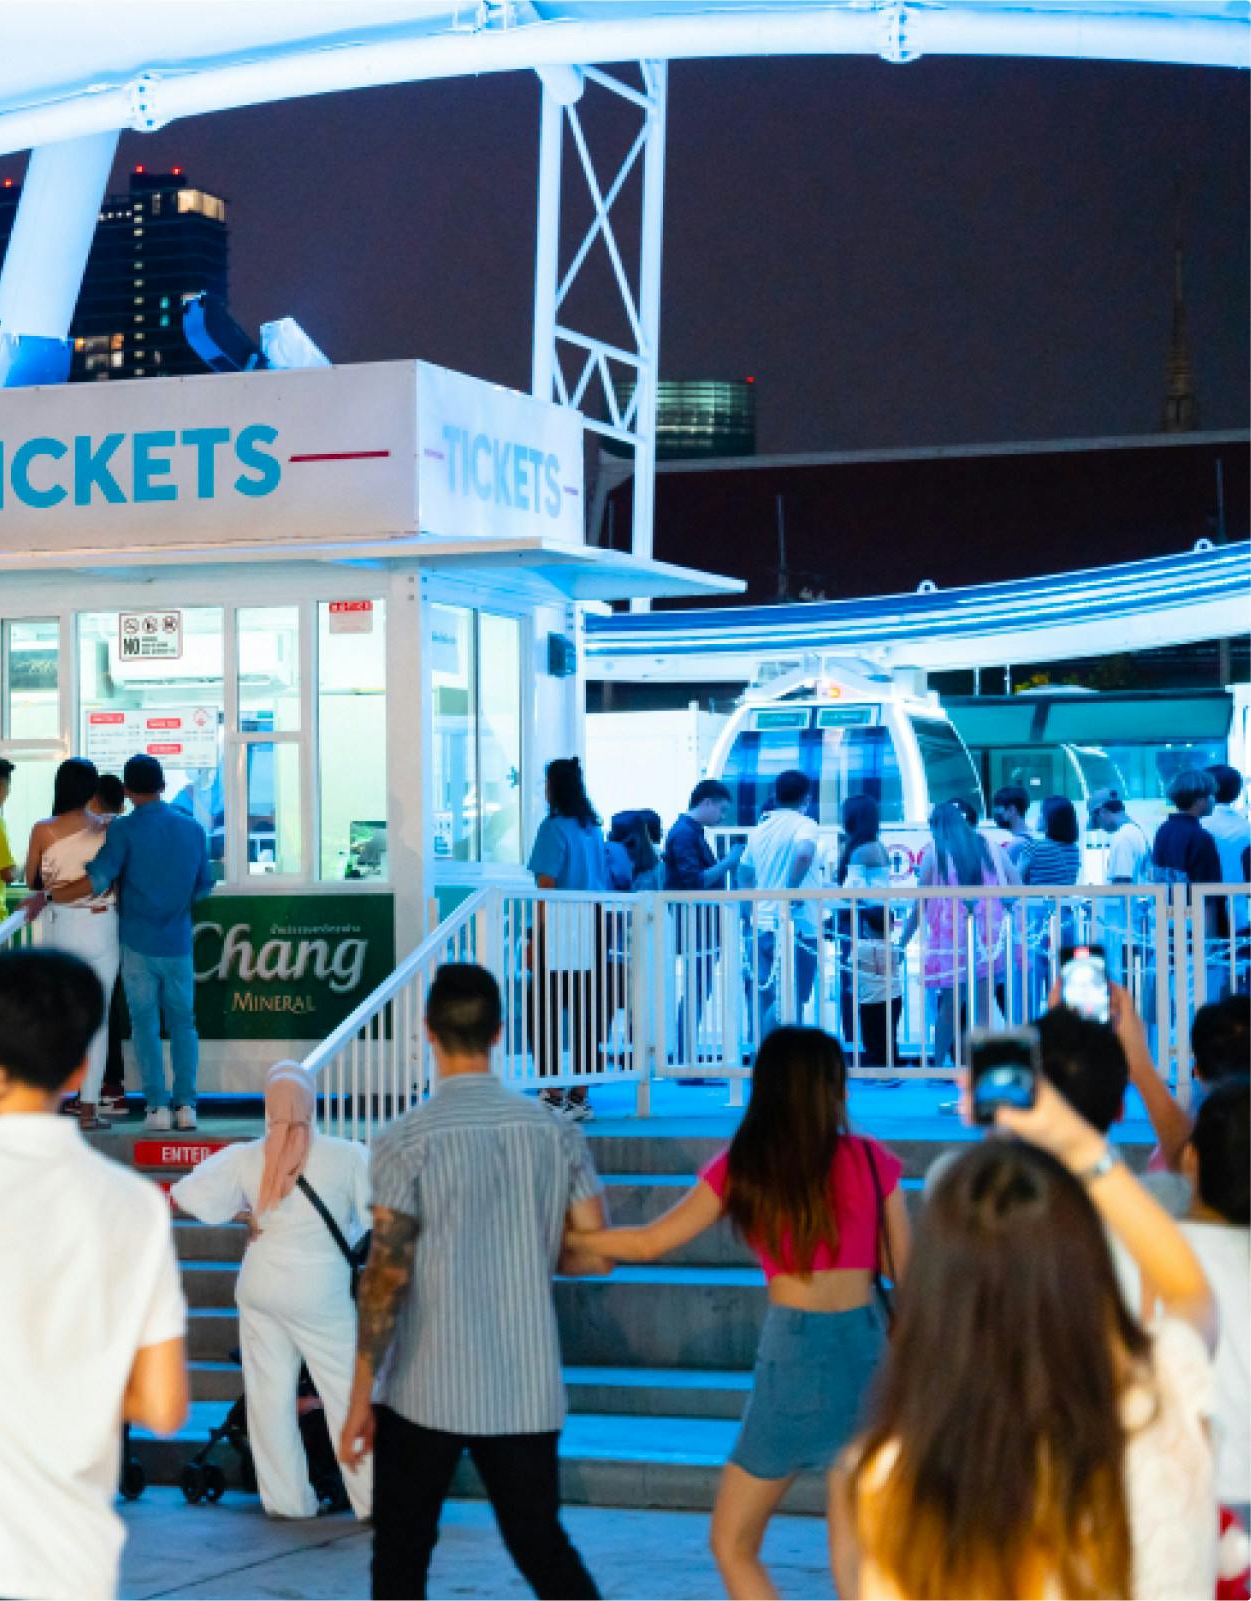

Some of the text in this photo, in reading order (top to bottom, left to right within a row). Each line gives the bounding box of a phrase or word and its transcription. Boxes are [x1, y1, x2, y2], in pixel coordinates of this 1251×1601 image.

[442, 425, 561, 519] TICKETS
[124, 637, 140, 655] NO
[192, 921, 368, 993] Chang
